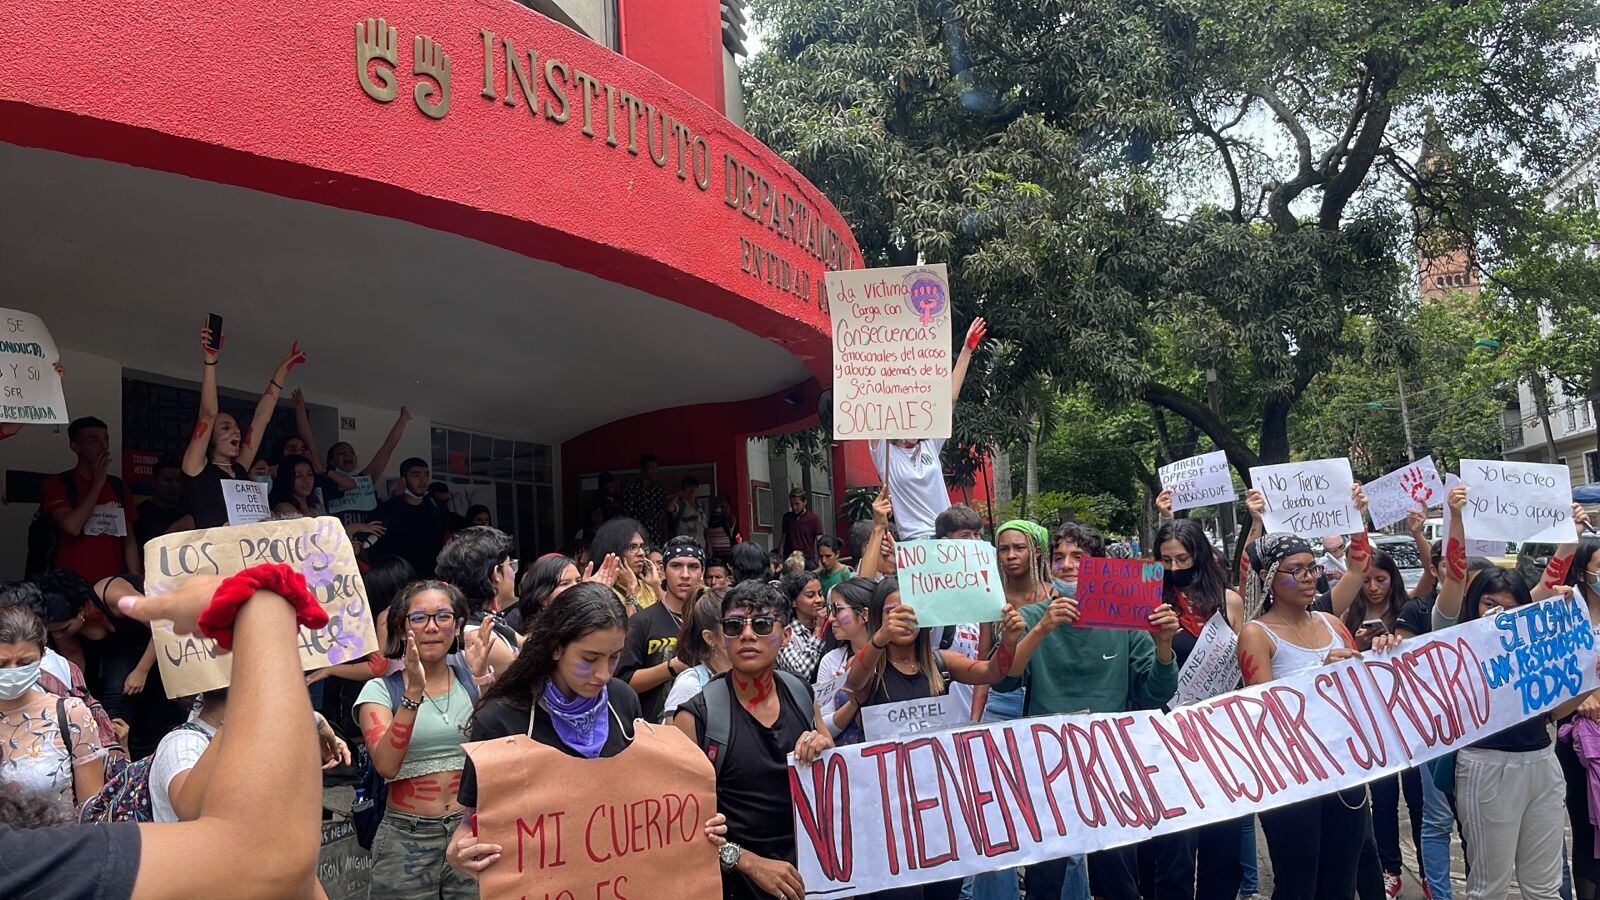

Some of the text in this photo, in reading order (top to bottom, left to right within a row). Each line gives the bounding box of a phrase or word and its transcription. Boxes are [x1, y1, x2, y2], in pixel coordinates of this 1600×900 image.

[480, 29, 711, 190] INSTITUTO
[740, 236, 811, 303] ENTIDAD
[7, 317, 24, 333] SE
[0, 341, 45, 359] ONDUCTA,
[901, 346, 915, 361] del
[918, 348, 946, 360] acoso
[9, 362, 40, 381] Y SU
[844, 364, 876, 377] abuso
[920, 364, 932, 376] de
[935, 364, 948, 377] los
[4, 386, 23, 399] SER
[1161, 457, 1204, 476] EL MACHO
[1210, 465, 1219, 473] ES
[1501, 467, 1521, 484] les
[235, 483, 262, 495] CARTEL
[247, 494, 259, 503] DE
[1178, 484, 1226, 504] ABUSADOR
[1282, 494, 1327, 510] derecho a
[1282, 504, 1351, 533] TOCARME!
[1525, 505, 1565, 528] apoyo
[160, 541, 219, 577] LOS
[239, 533, 329, 571] PROFES
[936, 543, 967, 572] SOY
[1142, 561, 1164, 583] NO
[1494, 612, 1525, 652] SI
[1179, 648, 1206, 687] TIENES
[887, 702, 946, 723] CARTEL
[788, 636, 1493, 882] NO TIENEN PORQUE MOSTRAR SU ROSTRO
[515, 792, 700, 873] MI CUERPO
